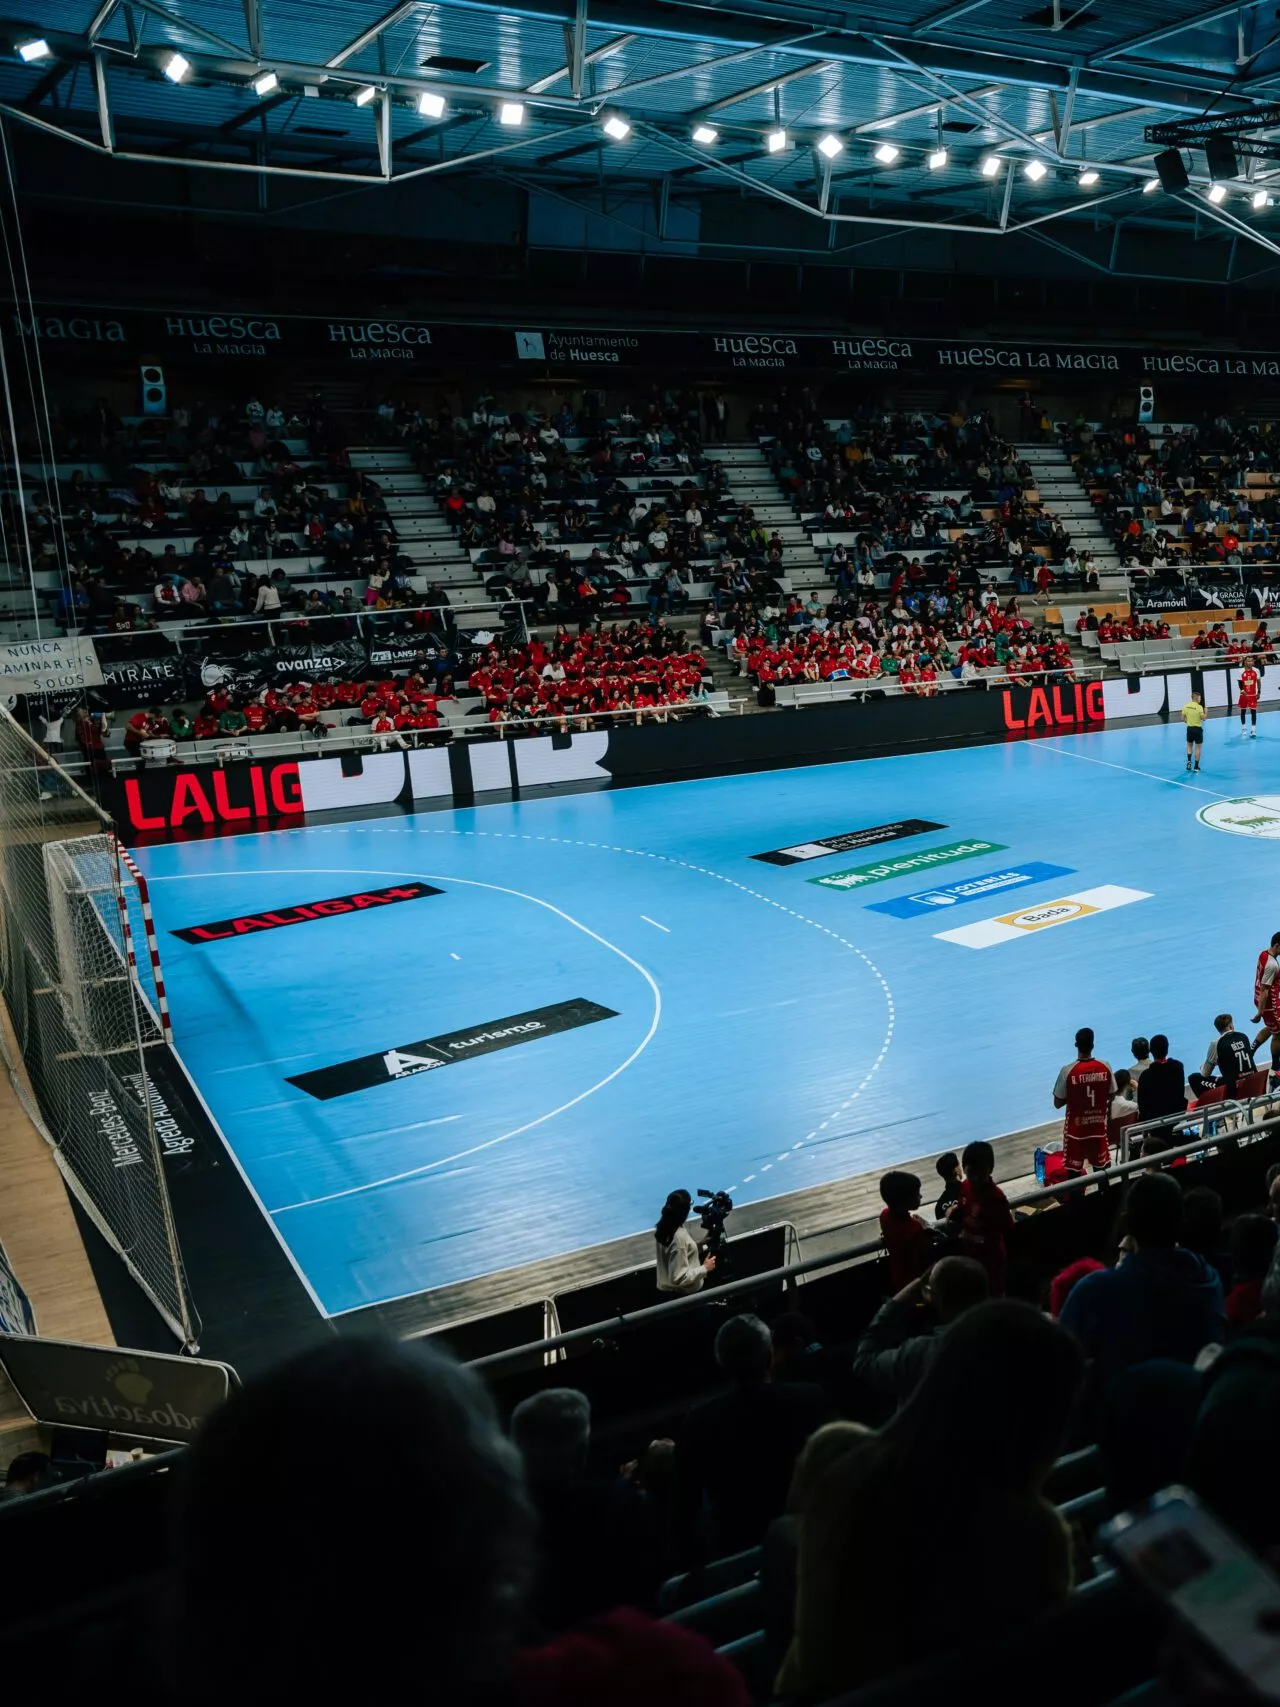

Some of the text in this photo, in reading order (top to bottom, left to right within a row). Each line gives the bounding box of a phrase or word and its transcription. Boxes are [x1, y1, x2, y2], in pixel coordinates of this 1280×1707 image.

[547, 333, 639, 349] Ayuntamiento
[549, 348, 620, 362] de Huesca
[1146, 596, 1188, 609] Aramóvil
[7, 642, 62, 657] NUNCA
[276, 656, 333, 672] avanza
[33, 674, 85, 690] SOLOS
[868, 838, 991, 878] plenitude
[945, 871, 1021, 894] LOTERÍAS
[1022, 906, 1068, 923] Bada
[448, 1021, 541, 1050] turismo
[1234, 1050, 1253, 1072] 74
[1086, 1085, 1095, 1108] 4
[88, 1088, 145, 1168] Mercedes-Benz
[155, 1114, 195, 1155] Agreda
